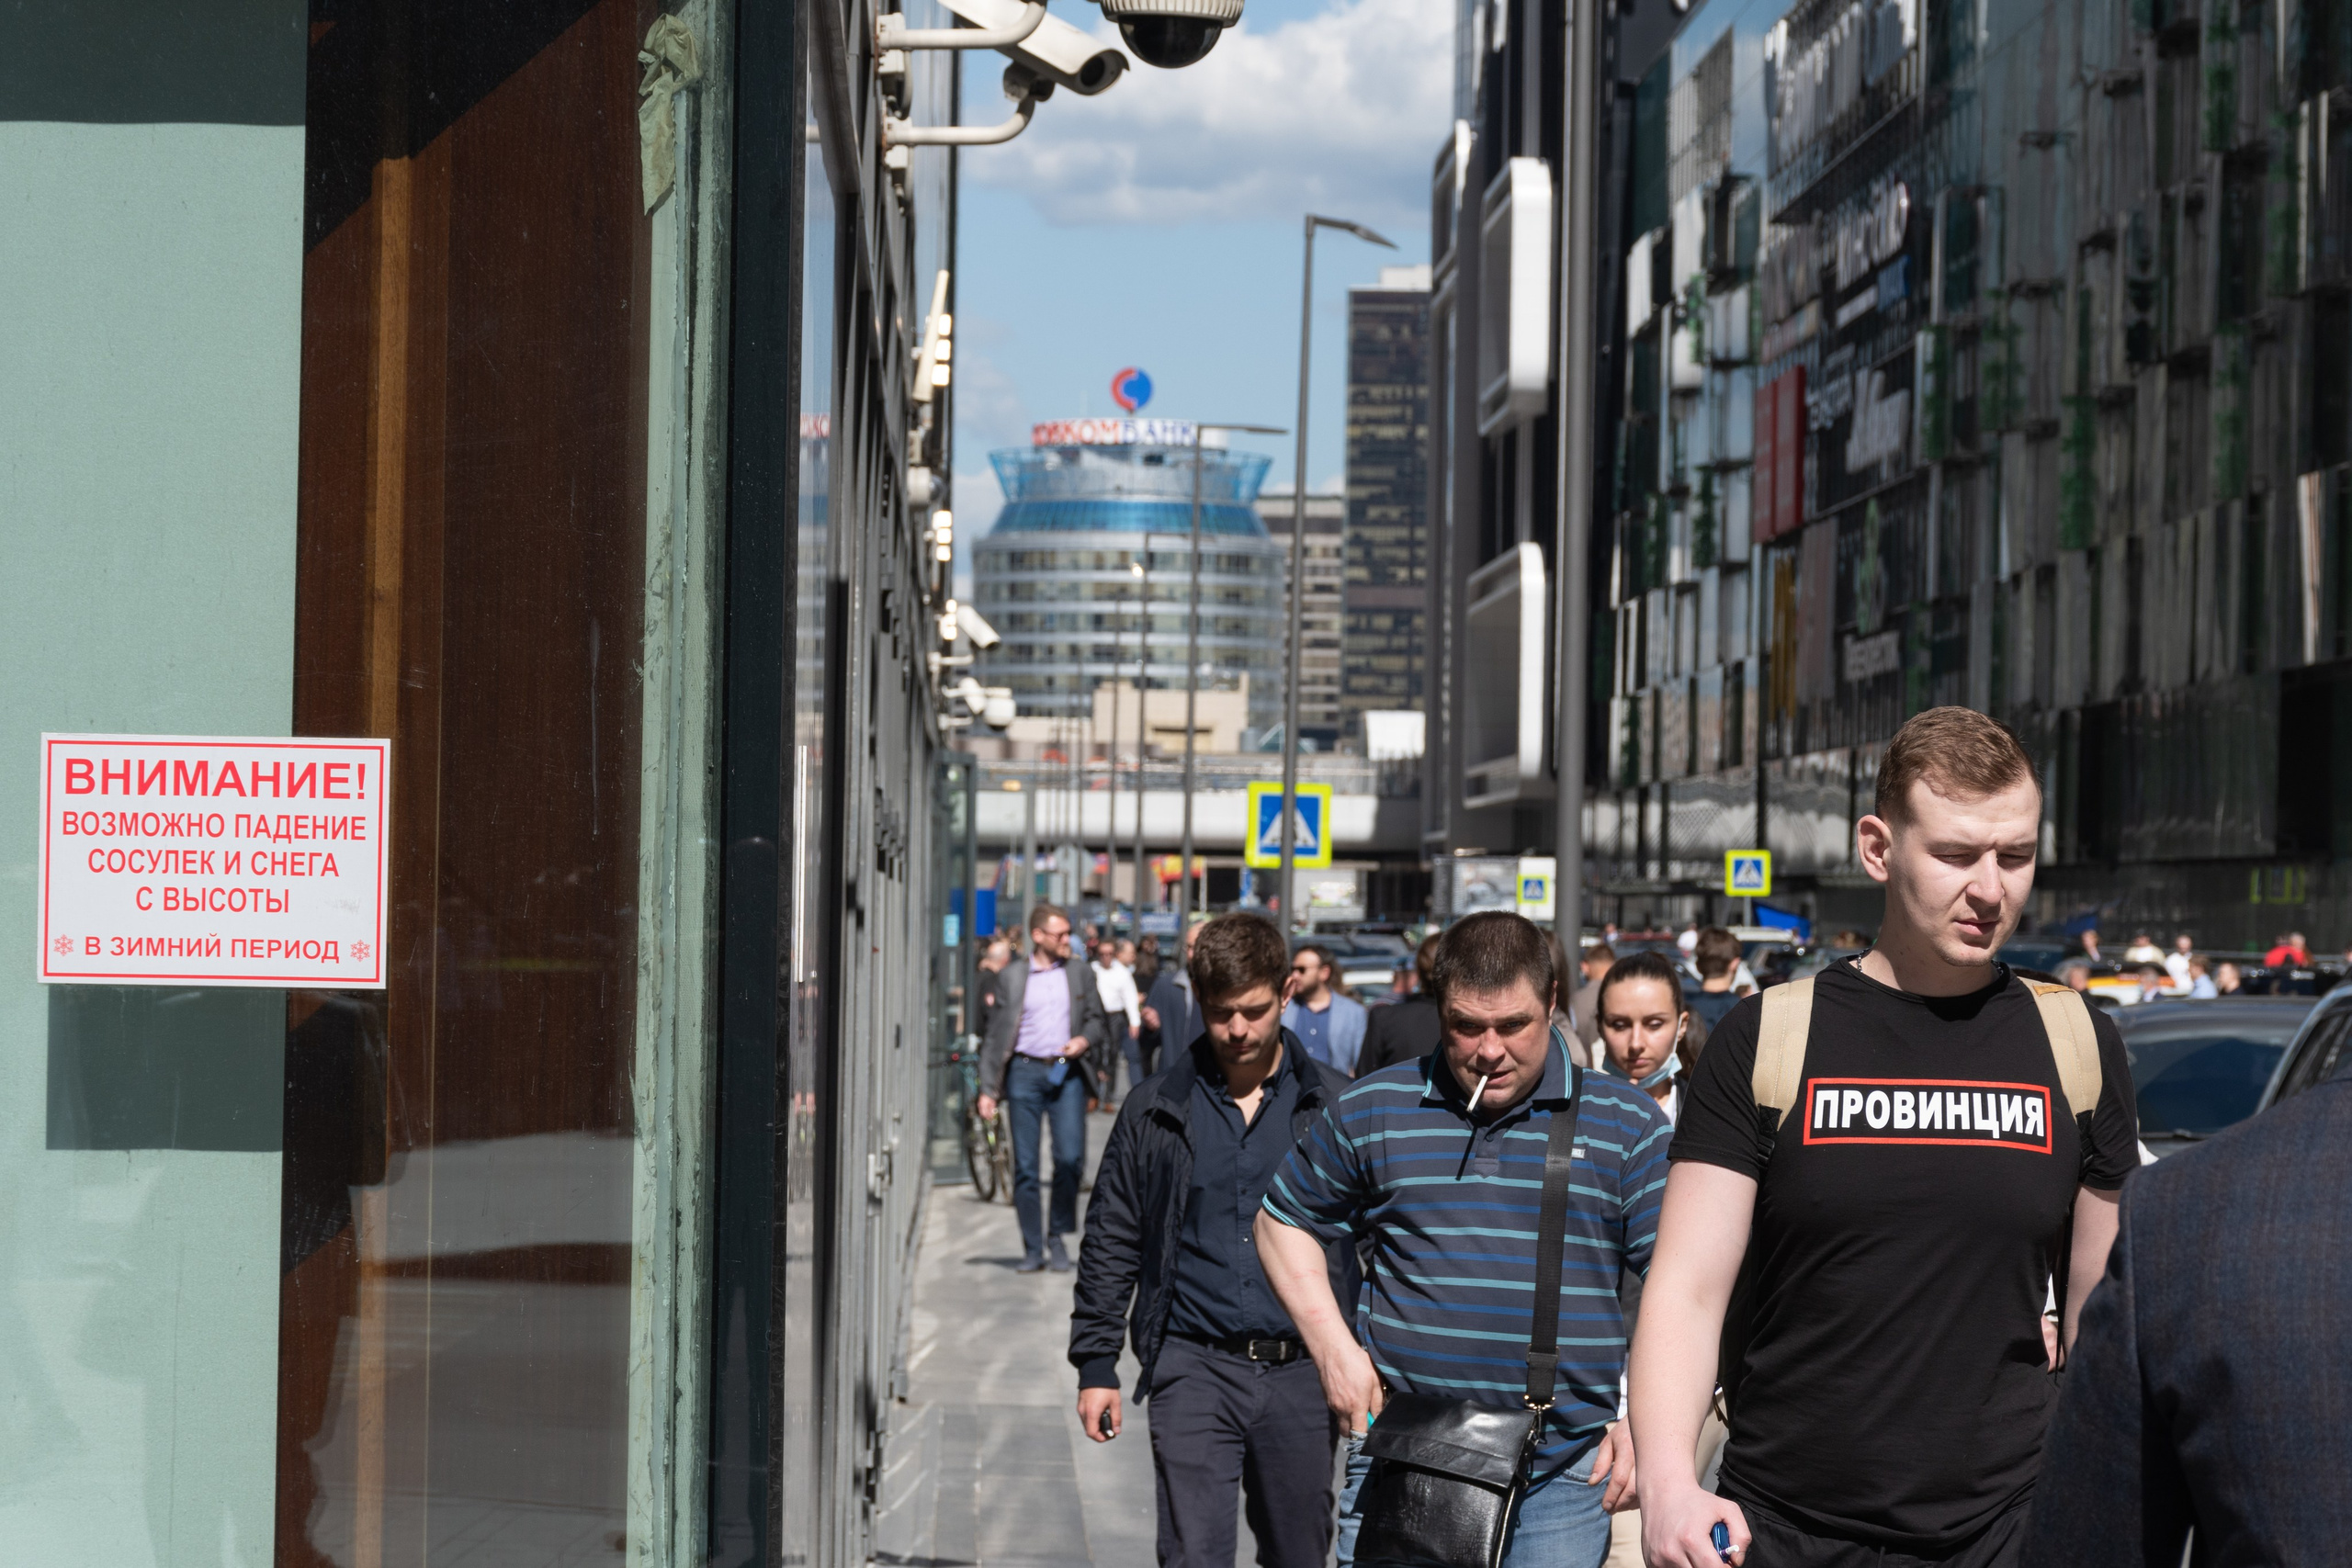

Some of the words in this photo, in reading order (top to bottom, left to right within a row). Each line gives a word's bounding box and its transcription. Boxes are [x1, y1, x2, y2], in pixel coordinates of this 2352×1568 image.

[1033, 419, 1197, 446] КОМБАНК
[64, 758, 367, 799] ВНИМАНИЕ!
[62, 811, 226, 838] ВОЗМОЖНО
[234, 814, 367, 844] ПАДЕНИЕ
[87, 848, 216, 875] СОСУЛЕК
[224, 851, 241, 875] И
[251, 851, 340, 877] СНЕГА
[136, 886, 153, 911] С
[163, 887, 289, 913] ВЫСОТЫ
[85, 936, 102, 955] В
[109, 932, 221, 957] ЗИМНИЙ
[231, 938, 340, 964] ПЕРИОД
[1814, 1089, 2045, 1139] ПРОВИНЦИЯ
